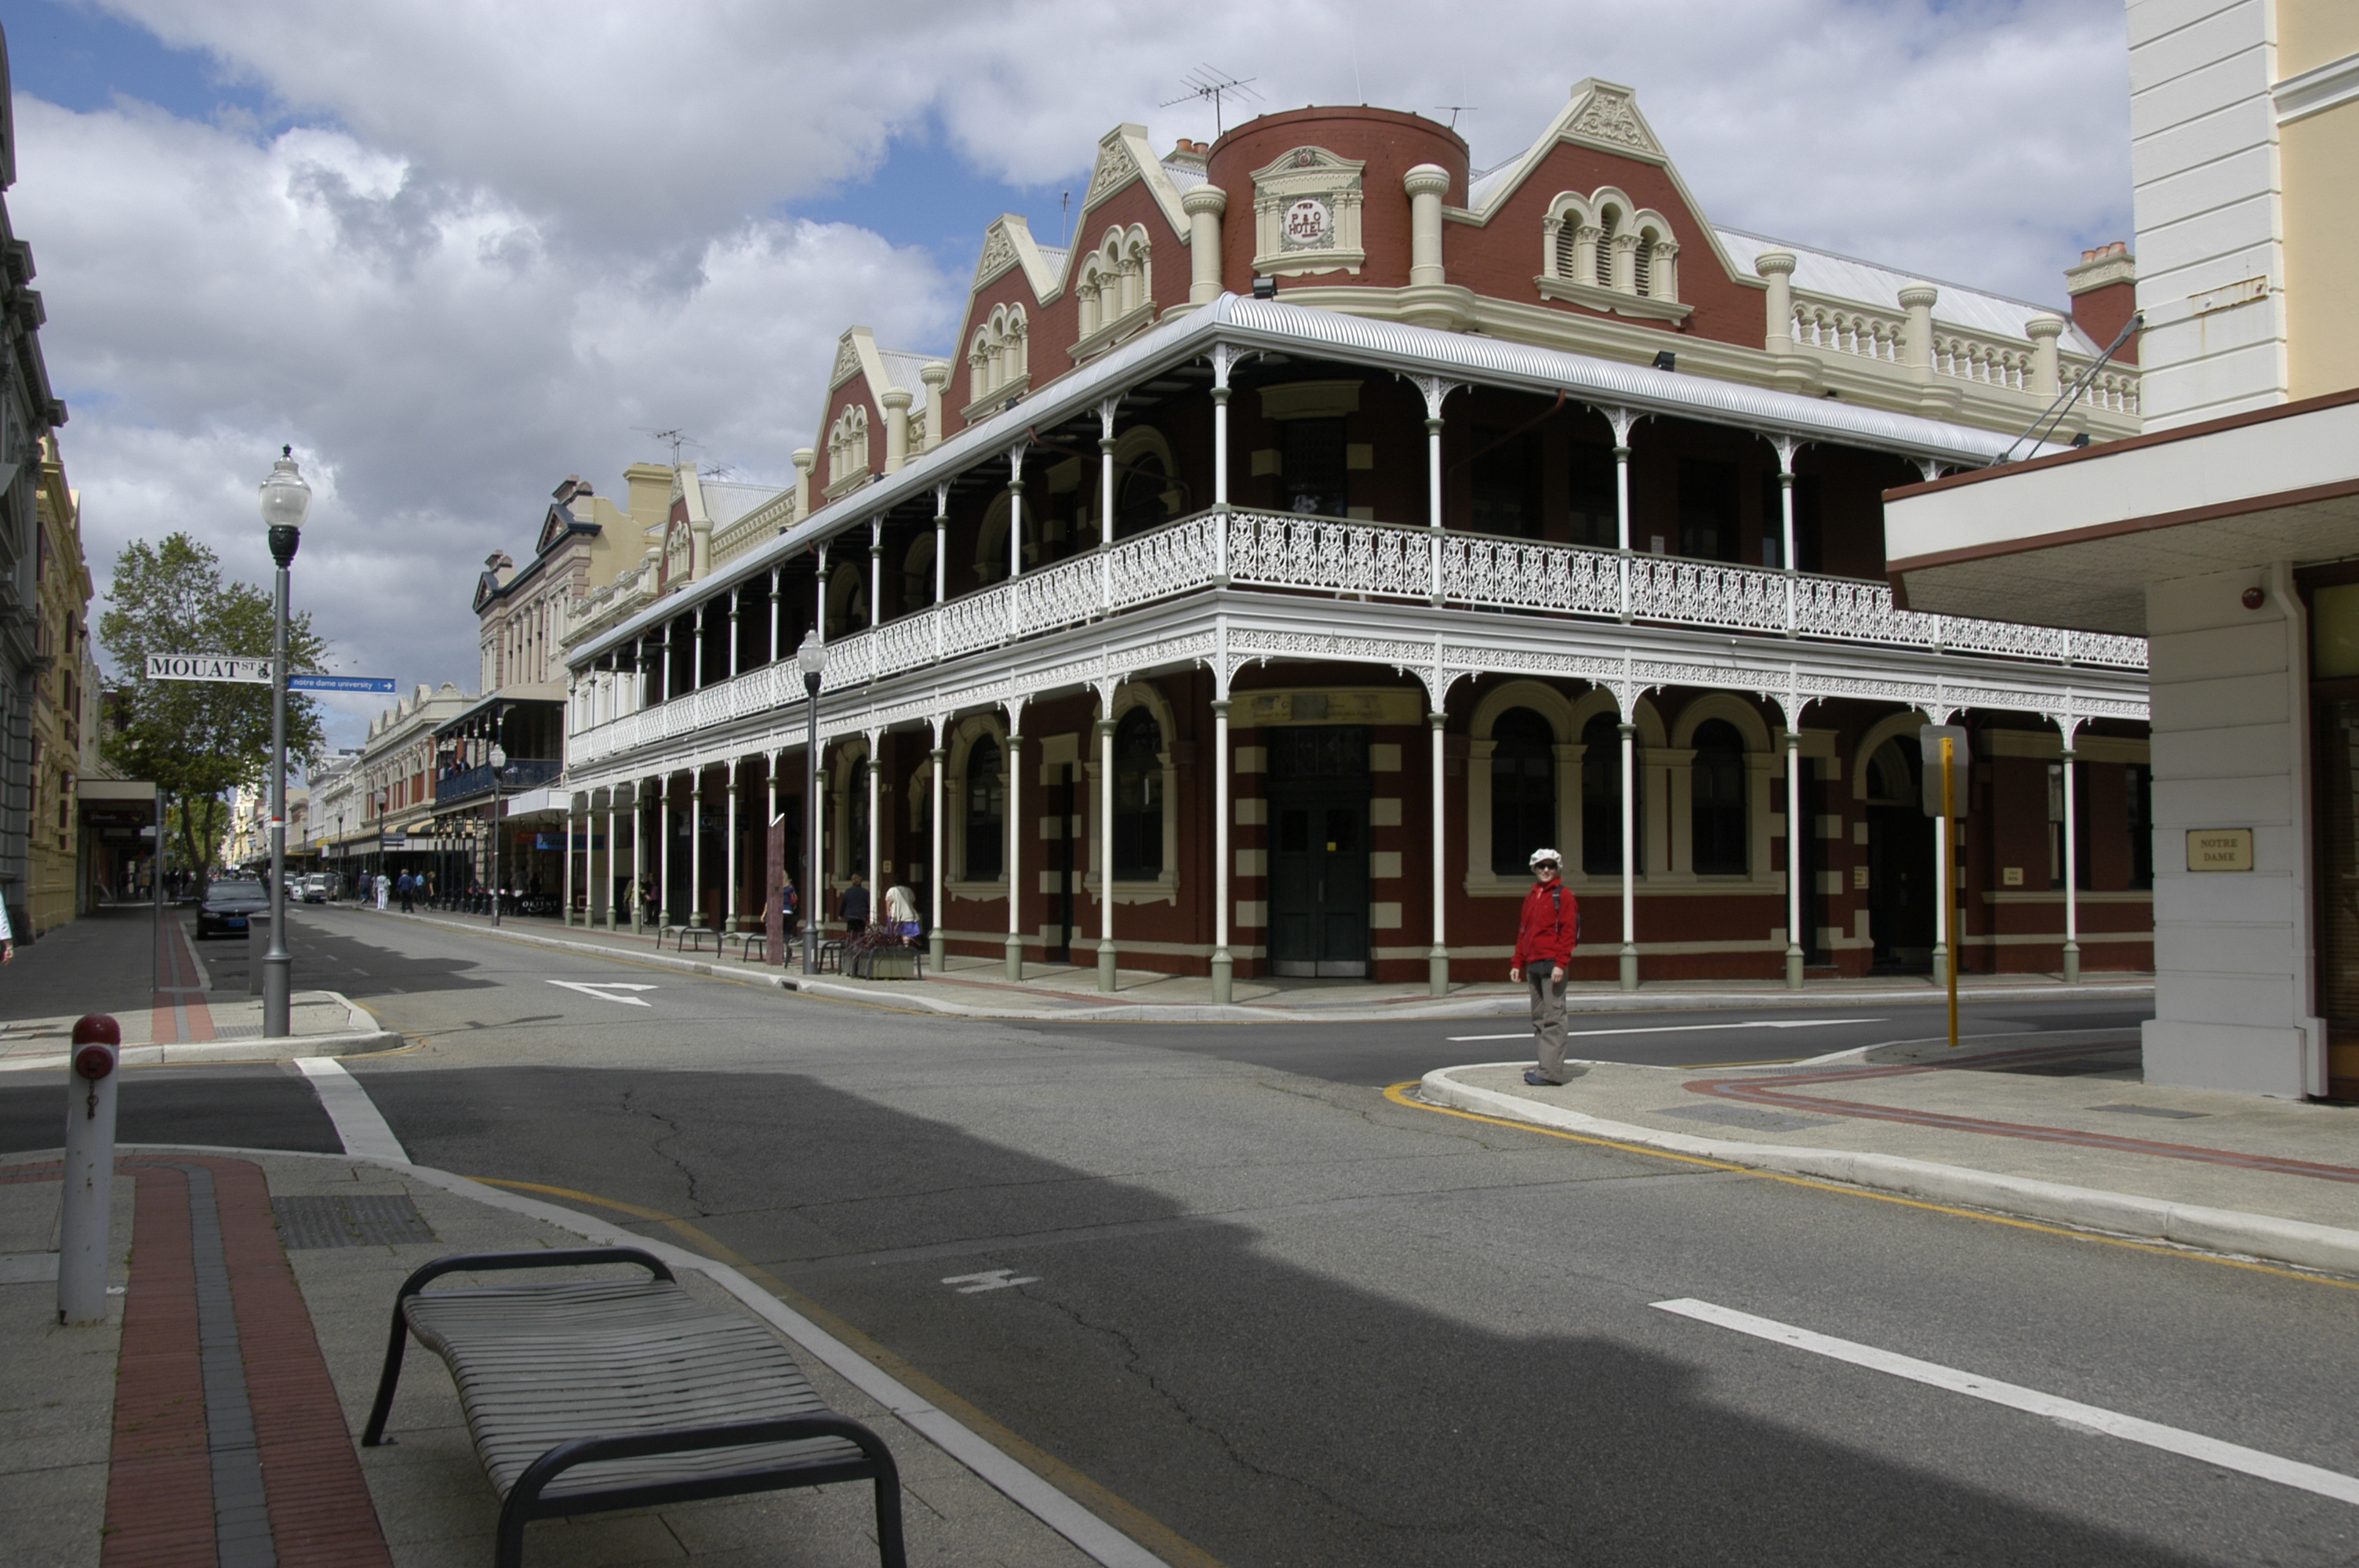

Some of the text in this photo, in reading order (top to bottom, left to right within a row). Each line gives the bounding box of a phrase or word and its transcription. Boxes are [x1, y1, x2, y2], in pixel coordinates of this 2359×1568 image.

[1292, 213, 1299, 223] P
[1314, 212, 1321, 221] O
[1289, 222, 1325, 234] HOTEL
[150, 658, 256, 677] MOUAT ST
[315, 679, 336, 688] dame
[337, 681, 373, 691] university
[2201, 838, 2237, 848] NOTRE
[2204, 852, 2235, 862] DAME
